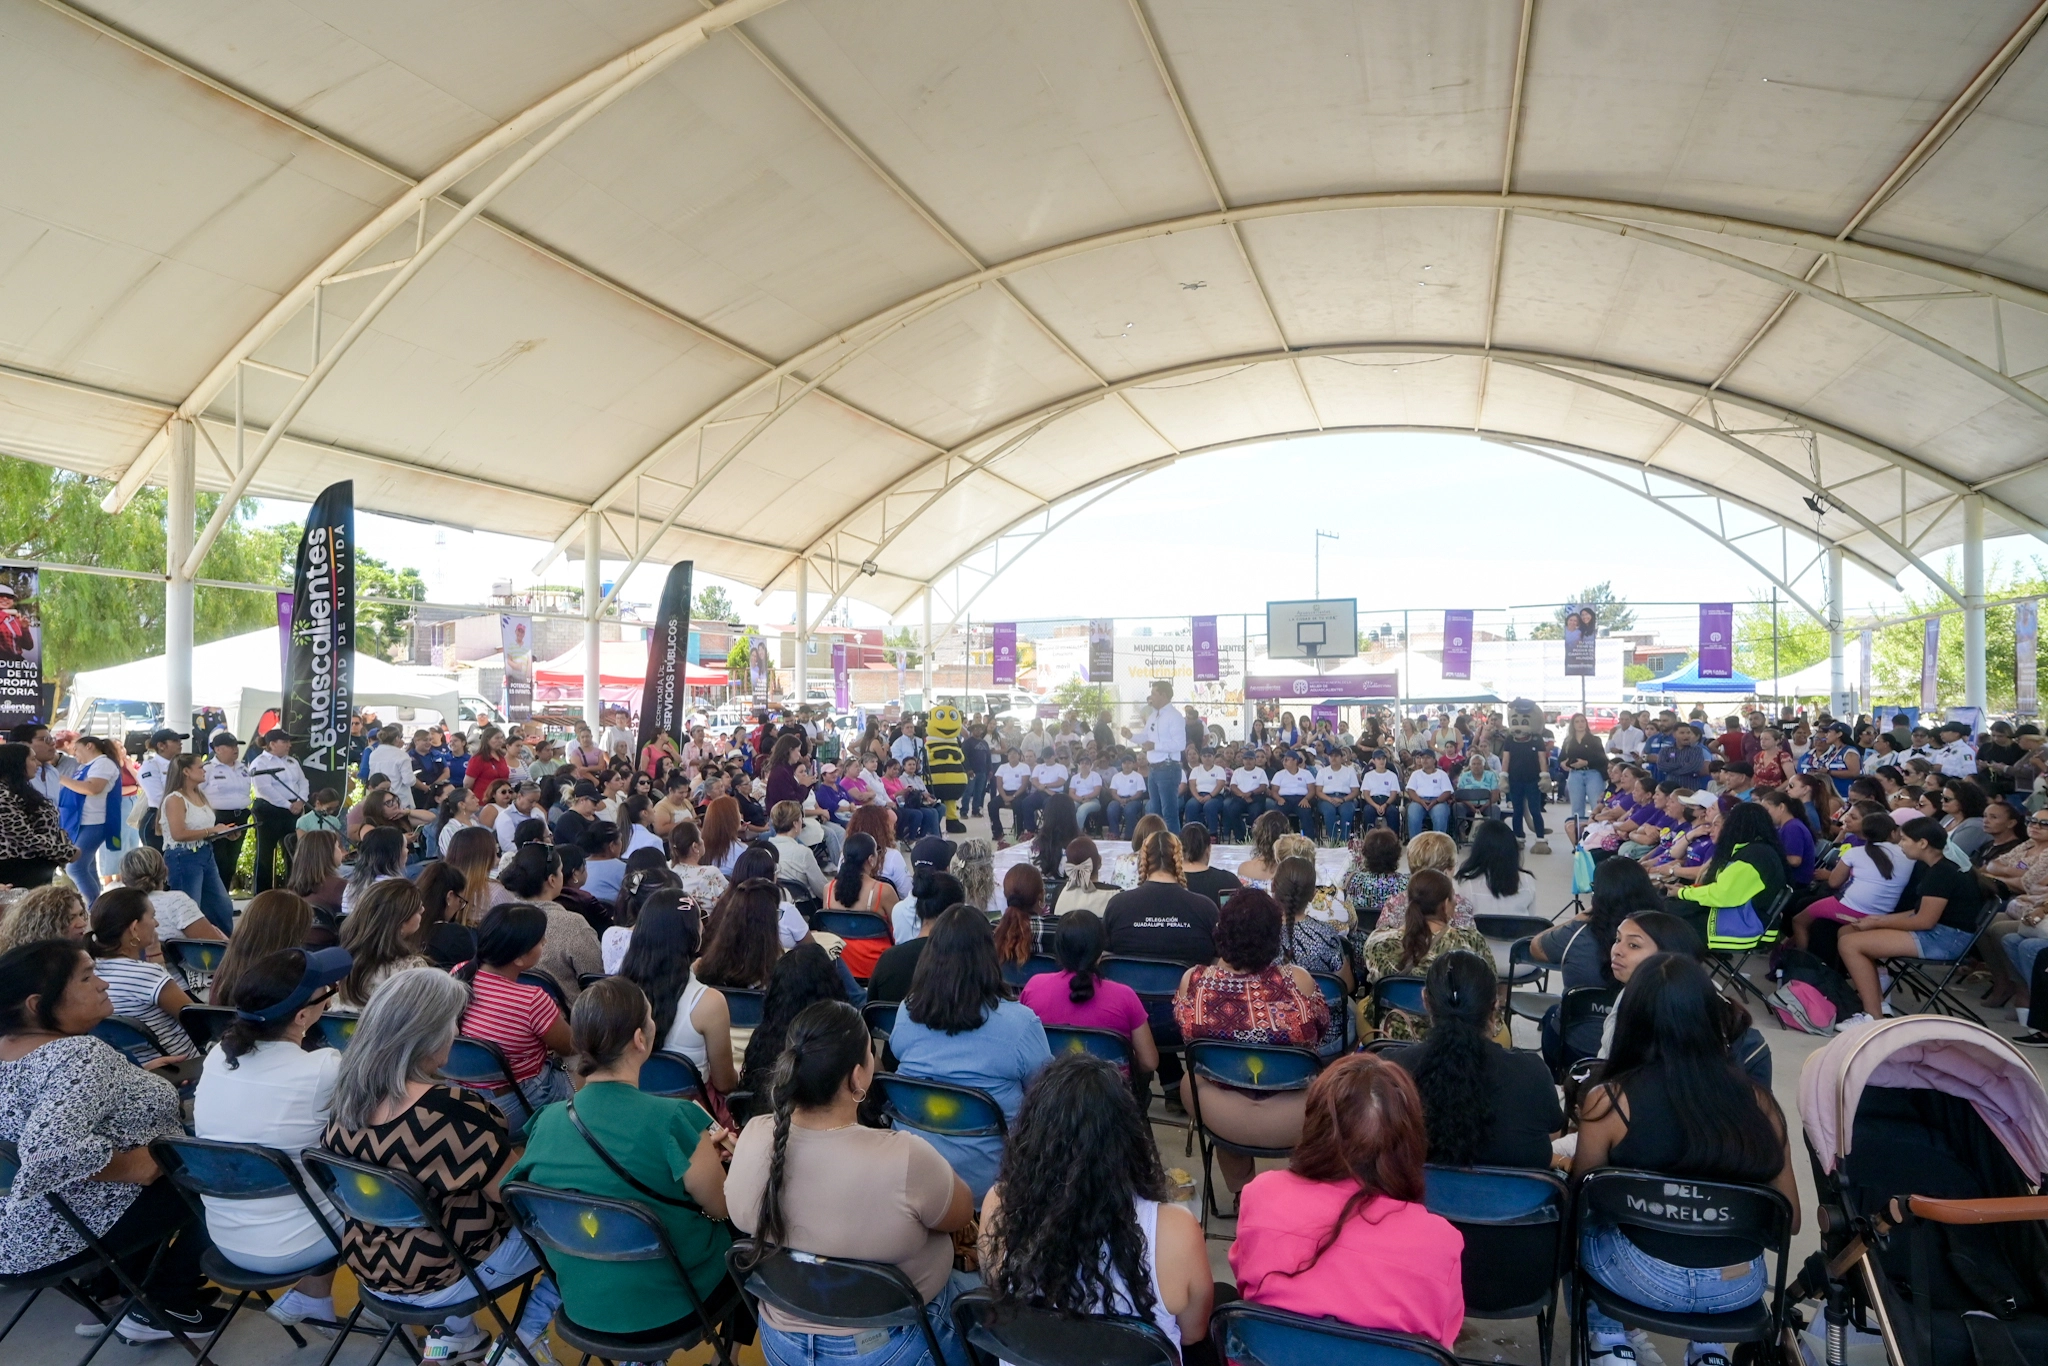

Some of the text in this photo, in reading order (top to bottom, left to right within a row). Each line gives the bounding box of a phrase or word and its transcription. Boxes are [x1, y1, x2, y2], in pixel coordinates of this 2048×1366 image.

[302, 526, 338, 772] Aguascalientes
[334, 523, 348, 771] LA CIUDAD DE TU VIDA
[1133, 644, 1174, 652] MUNICIPIO
[1174, 644, 1185, 652] DE
[0, 660, 38, 669] DUEÑA
[1144, 658, 1177, 666] Quirófano
[7, 669, 38, 678] DE TU
[1128, 664, 1193, 677] Veterinario
[663, 619, 678, 732] SERVICIOS PÚBLICOS
[0, 687, 38, 696] TORIA.
[655, 679, 664, 728] ECRETARÍA
[1620, 1350, 1634, 1358] NIKE
[1708, 1357, 1724, 1365] NIKE
